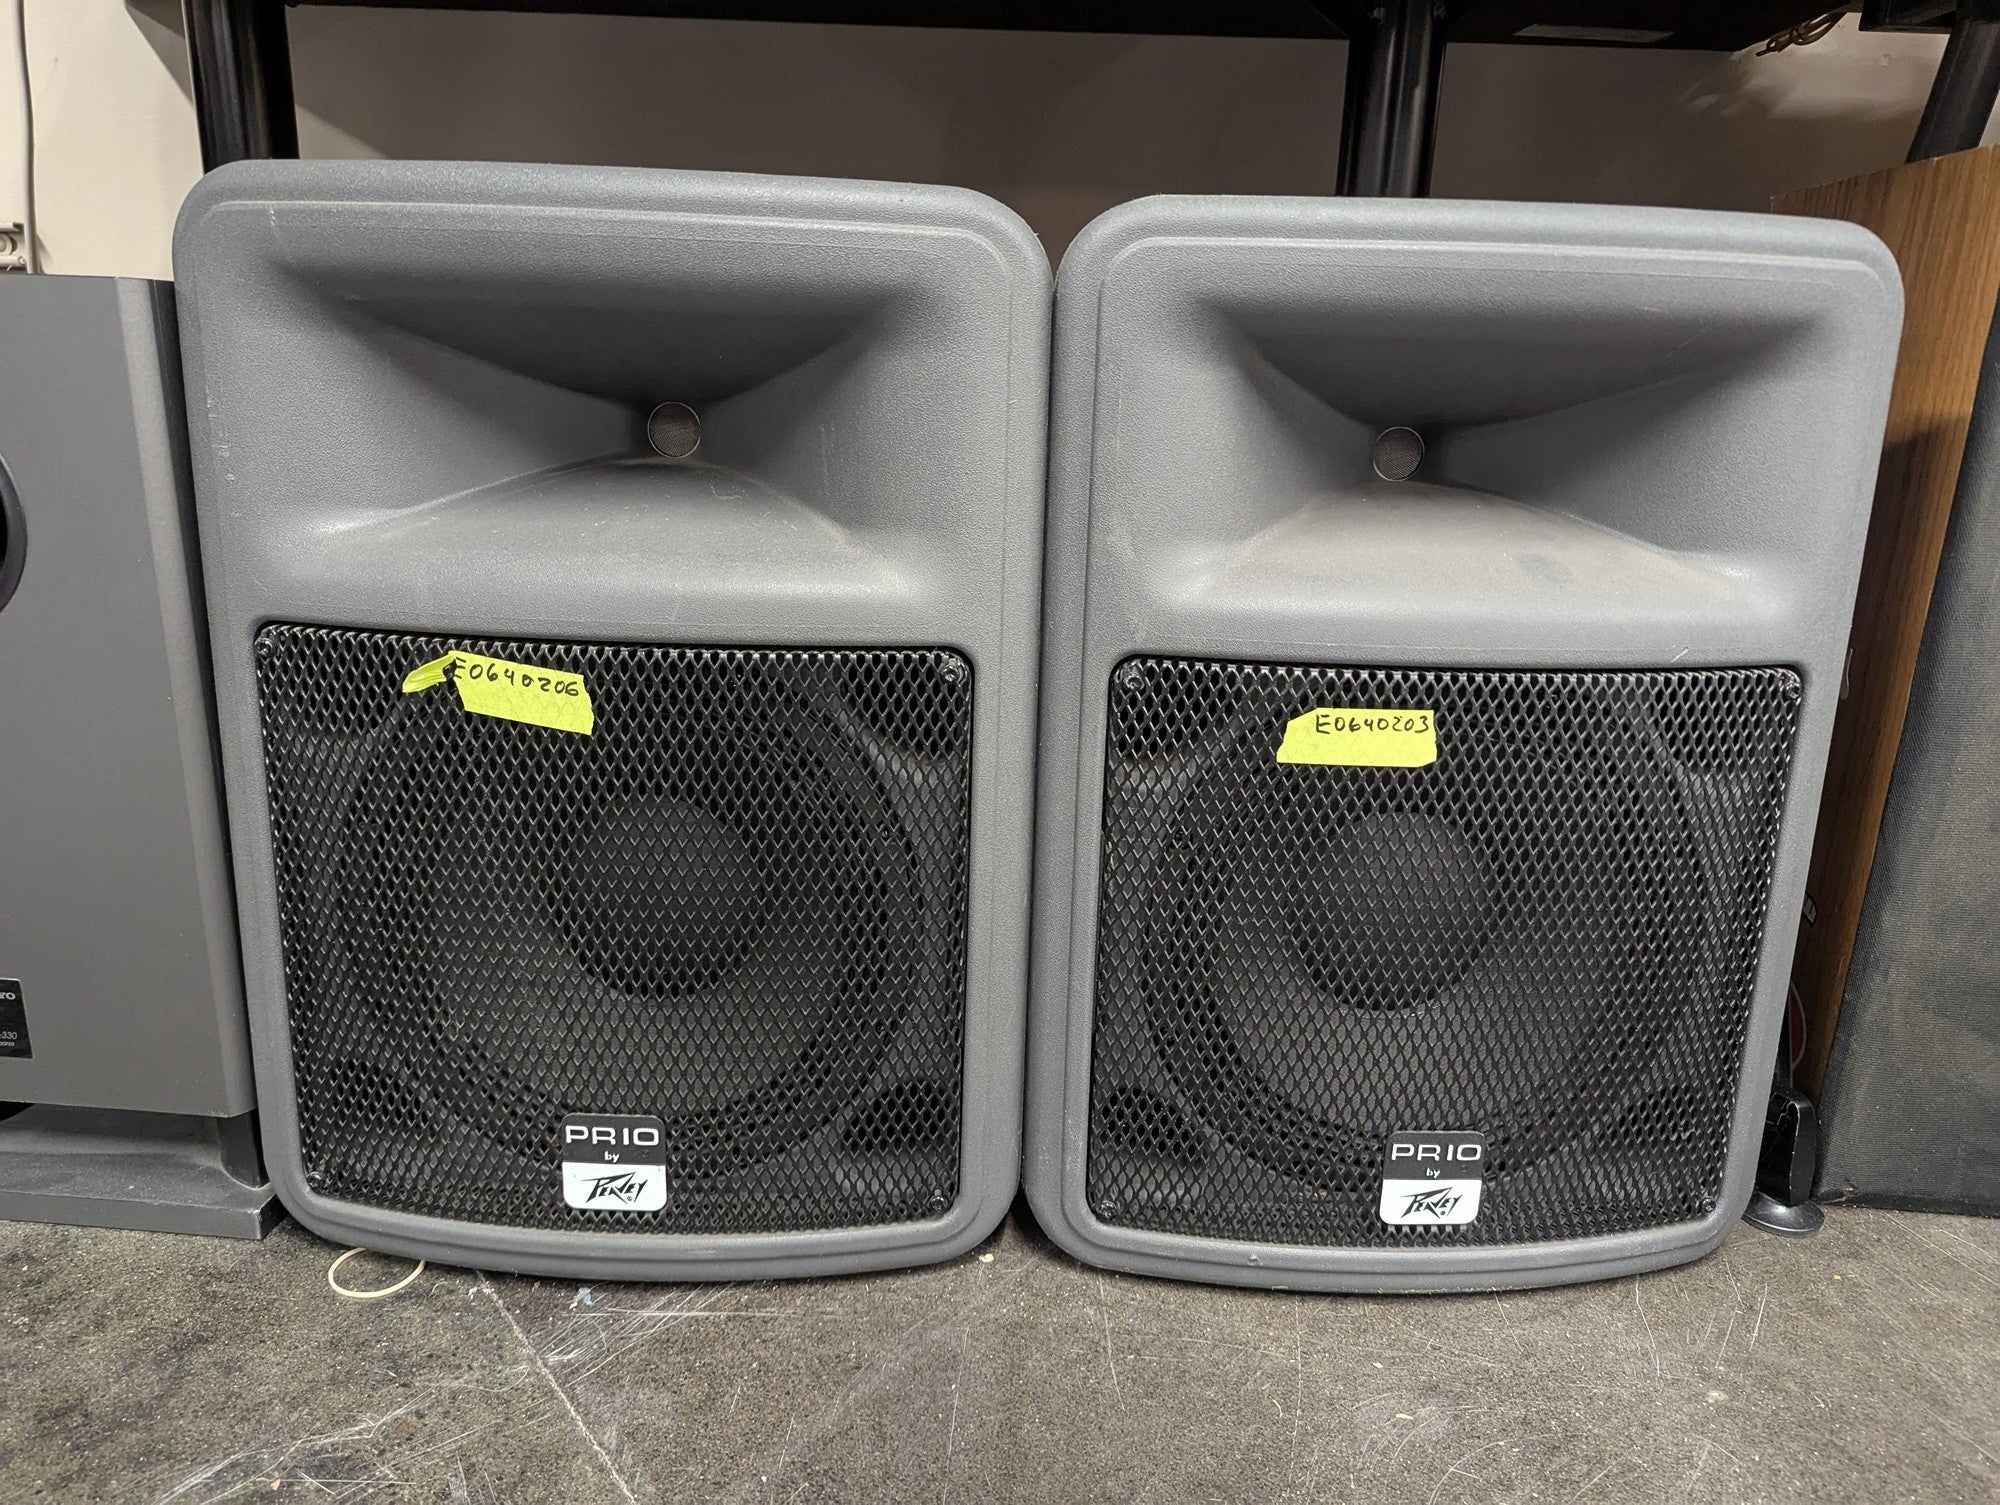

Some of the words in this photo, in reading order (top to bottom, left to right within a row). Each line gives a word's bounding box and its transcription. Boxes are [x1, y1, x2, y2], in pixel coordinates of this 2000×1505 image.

[1316, 714, 1429, 735] E0640203
[604, 1150, 620, 1163] by
[1426, 1167, 1440, 1178] by
